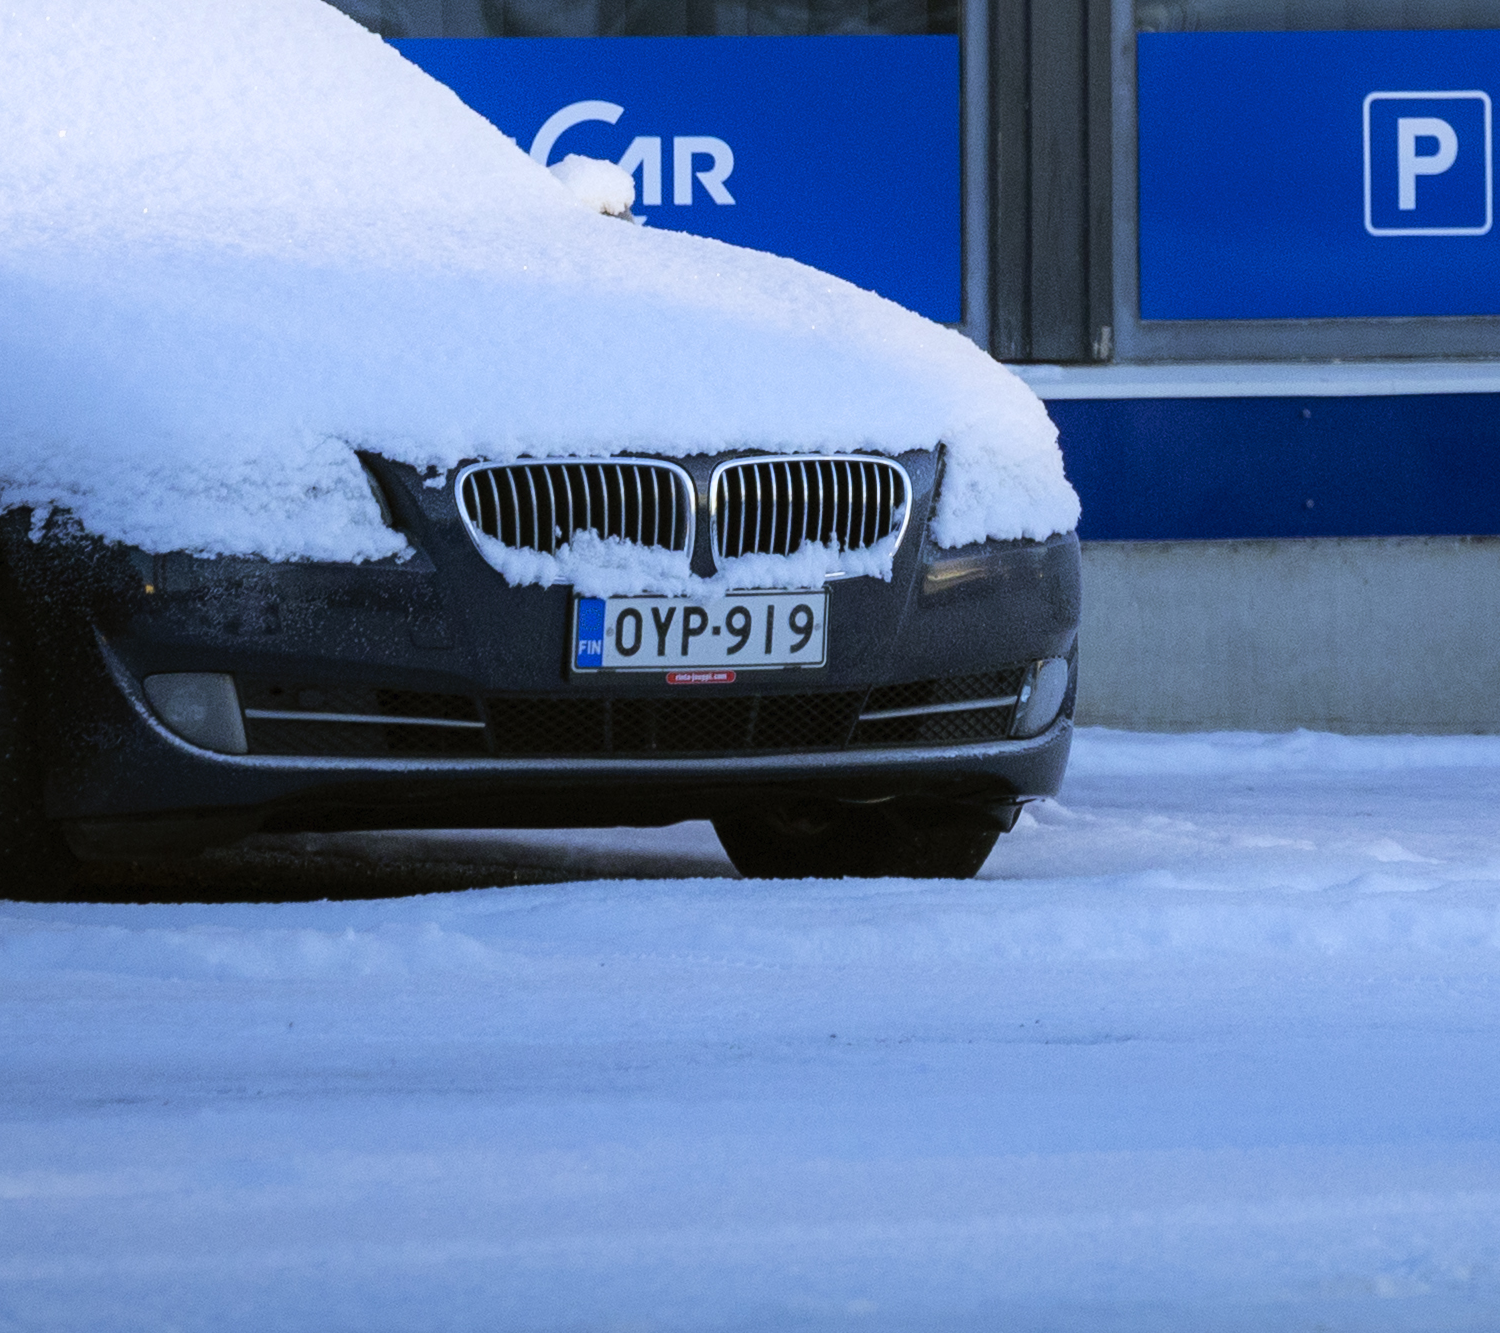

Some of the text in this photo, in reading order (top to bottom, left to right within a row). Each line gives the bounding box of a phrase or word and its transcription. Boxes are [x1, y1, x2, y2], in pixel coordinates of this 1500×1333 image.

[1397, 116, 1460, 211] P
[577, 638, 603, 656] FIN
[613, 603, 817, 658] OYP-919
